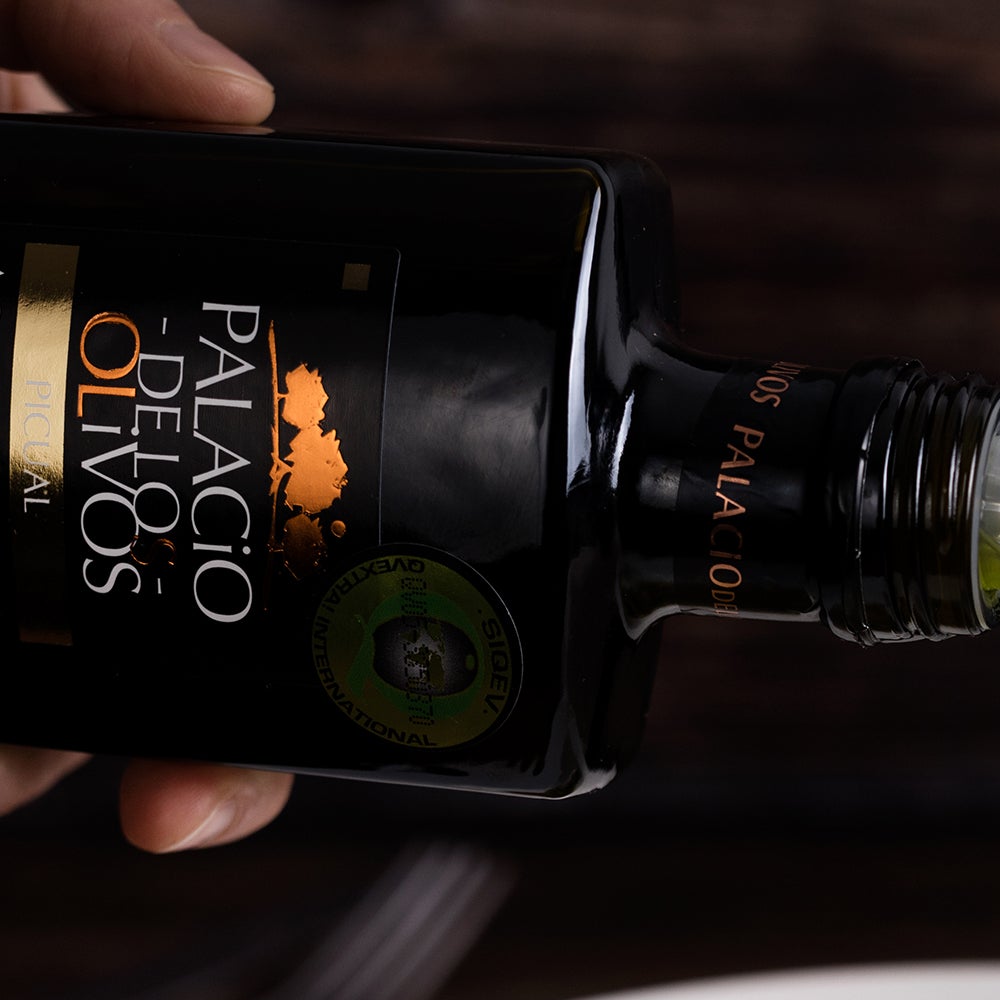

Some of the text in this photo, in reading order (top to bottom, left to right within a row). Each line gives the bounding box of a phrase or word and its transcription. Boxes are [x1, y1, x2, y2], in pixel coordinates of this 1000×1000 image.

[23, 379, 51, 513] PICUAL
[130, 352, 184, 567] DE LOS
[313, 615, 438, 746] INTERNATIONAL
